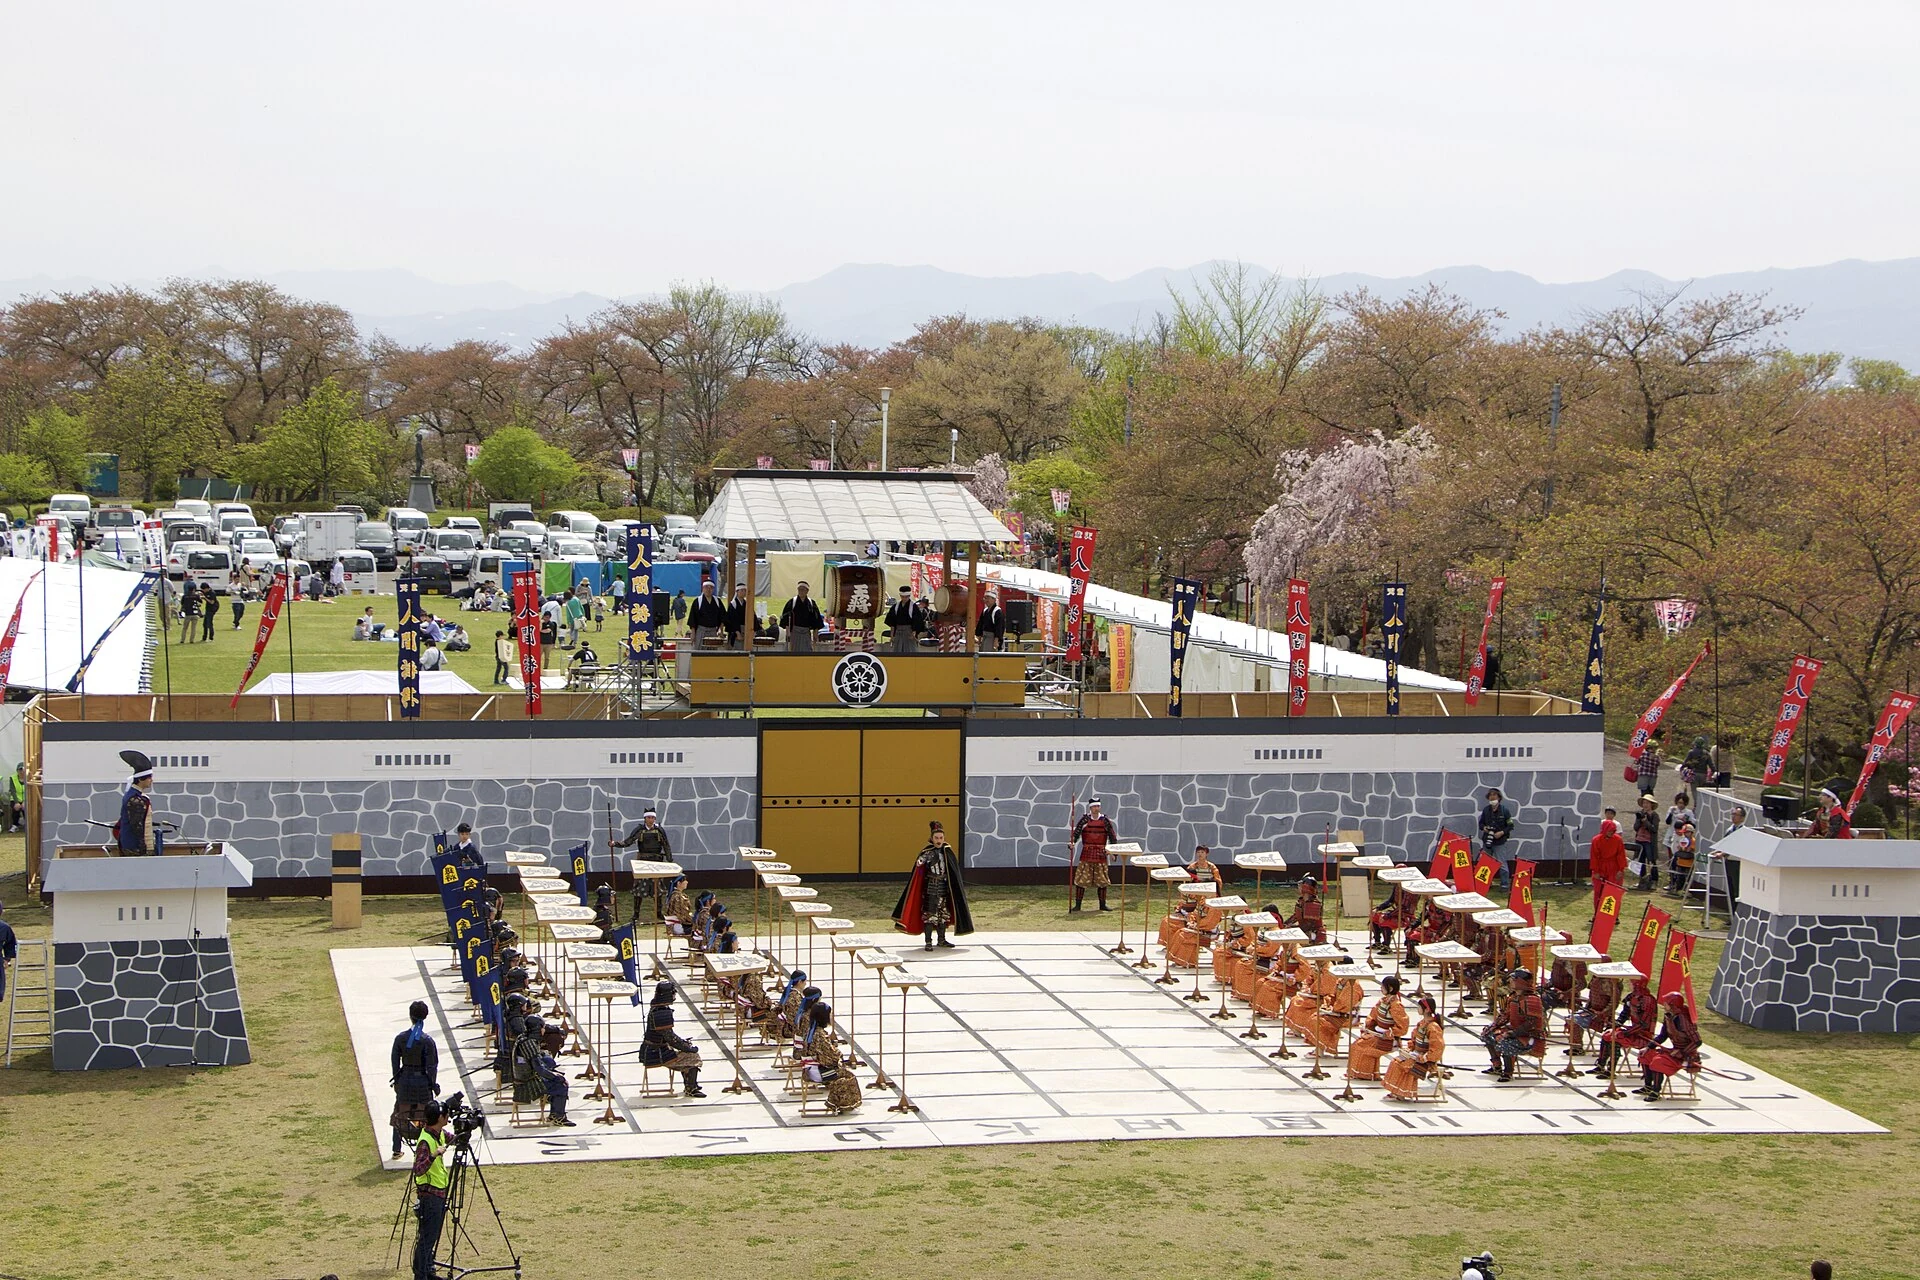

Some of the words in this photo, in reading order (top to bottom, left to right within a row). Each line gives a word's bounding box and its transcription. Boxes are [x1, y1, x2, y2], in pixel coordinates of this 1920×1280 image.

[628, 543, 653, 653] 人間将棋
[555, 925, 598, 936] 金将
[592, 981, 633, 992] 香車
[1530, 1113, 1595, 1128] 二
[833, 1126, 895, 1143] 七
[975, 1121, 1040, 1138] 六
[688, 1134, 749, 1149] 八
